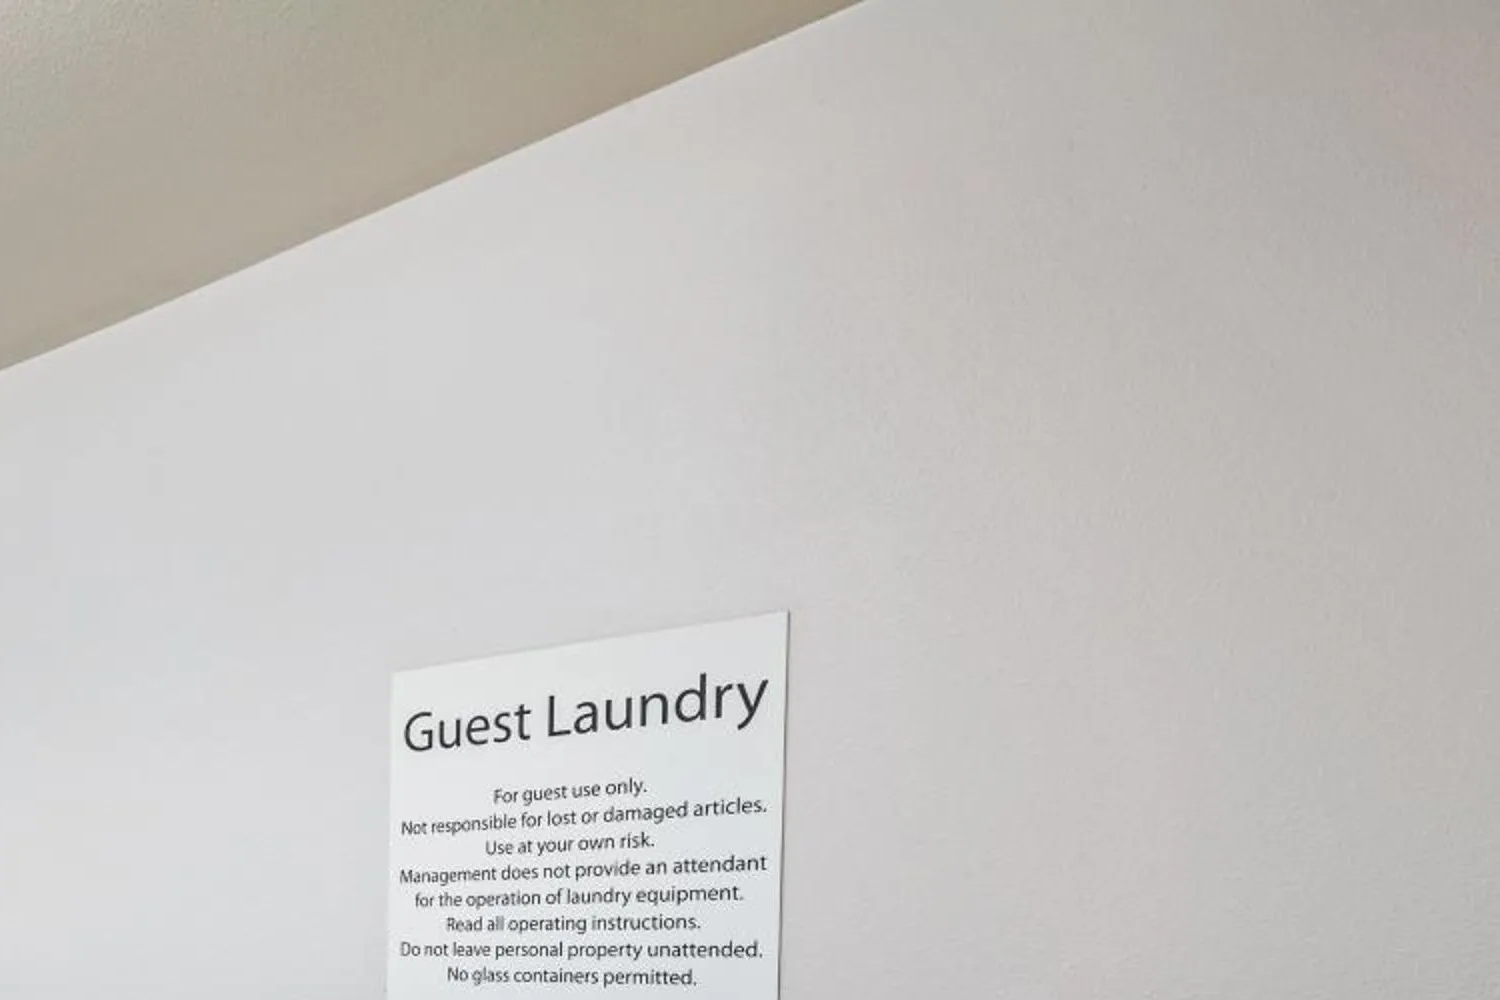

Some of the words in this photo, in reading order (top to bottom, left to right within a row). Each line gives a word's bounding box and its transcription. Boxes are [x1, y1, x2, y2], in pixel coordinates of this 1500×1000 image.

[403, 703, 532, 753] Guest
[547, 671, 769, 738] Laundry
[493, 788, 519, 804] For
[521, 785, 568, 807] guest
[571, 783, 601, 799] use
[605, 776, 648, 798] only.
[401, 820, 428, 835] Not
[431, 813, 517, 836] responsible
[521, 811, 543, 828] for
[546, 810, 577, 827] lost
[581, 811, 600, 825] or
[603, 800, 689, 825] damaged
[692, 796, 767, 817] articles.
[485, 840, 515, 856] Use
[517, 840, 533, 855] at
[536, 839, 575, 857] your
[577, 837, 615, 851] own
[619, 831, 655, 849] risk.
[399, 867, 497, 887] Management
[500, 864, 539, 881] does
[543, 864, 571, 879] not
[575, 859, 641, 882] provide
[645, 861, 668, 875] an
[672, 854, 767, 875] attendant
[415, 892, 435, 908] for
[438, 891, 463, 907] the
[465, 890, 541, 910] operation
[545, 887, 563, 905] of
[566, 887, 632, 908] laundry
[635, 885, 744, 907] equipment.
[446, 915, 483, 933] Read
[487, 915, 505, 932] all
[507, 915, 587, 935] operating
[591, 913, 701, 931] instructions.
[400, 941, 421, 957] Do
[424, 943, 449, 957] not
[452, 941, 491, 957] leave
[495, 940, 564, 961] personal
[567, 943, 643, 962] property
[647, 939, 763, 959] unattended.
[447, 966, 469, 982] No
[471, 966, 510, 986] glass
[513, 967, 599, 985] containers
[603, 968, 697, 989] permitted.
